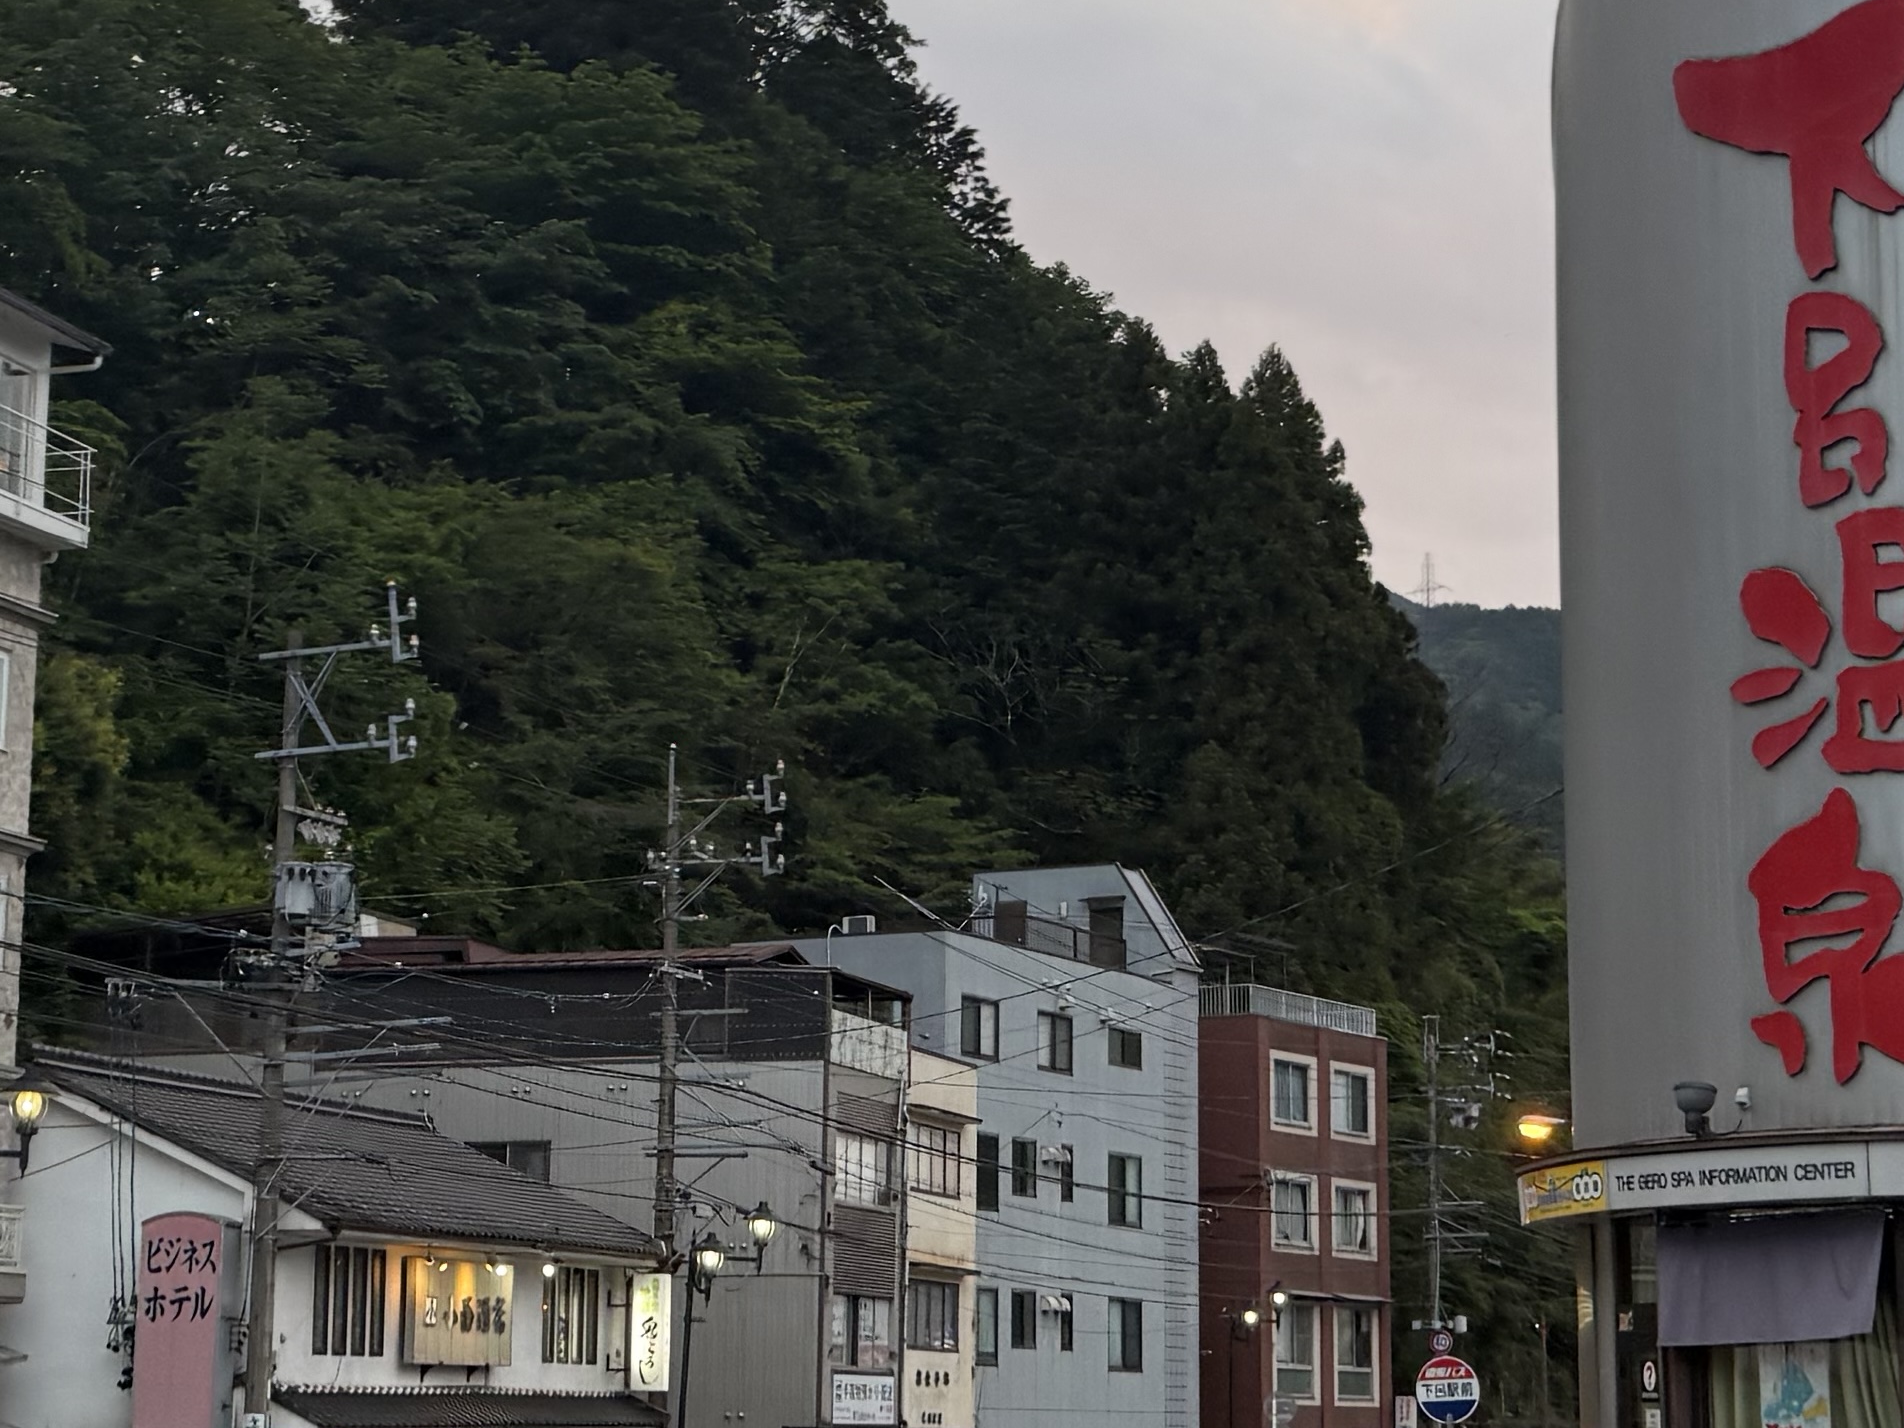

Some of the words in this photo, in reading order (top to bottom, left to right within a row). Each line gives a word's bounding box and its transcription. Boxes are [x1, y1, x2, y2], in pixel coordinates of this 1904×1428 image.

[1616, 1175, 1635, 1192] THE
[1638, 1172, 1667, 1190] GERO
[1671, 1170, 1695, 1188] SPA
[1698, 1164, 1788, 1186] INFORMATION
[1794, 1161, 1856, 1181] CENTER
[147, 1236, 217, 1274] ビジネス
[144, 1286, 215, 1322] ホテル
